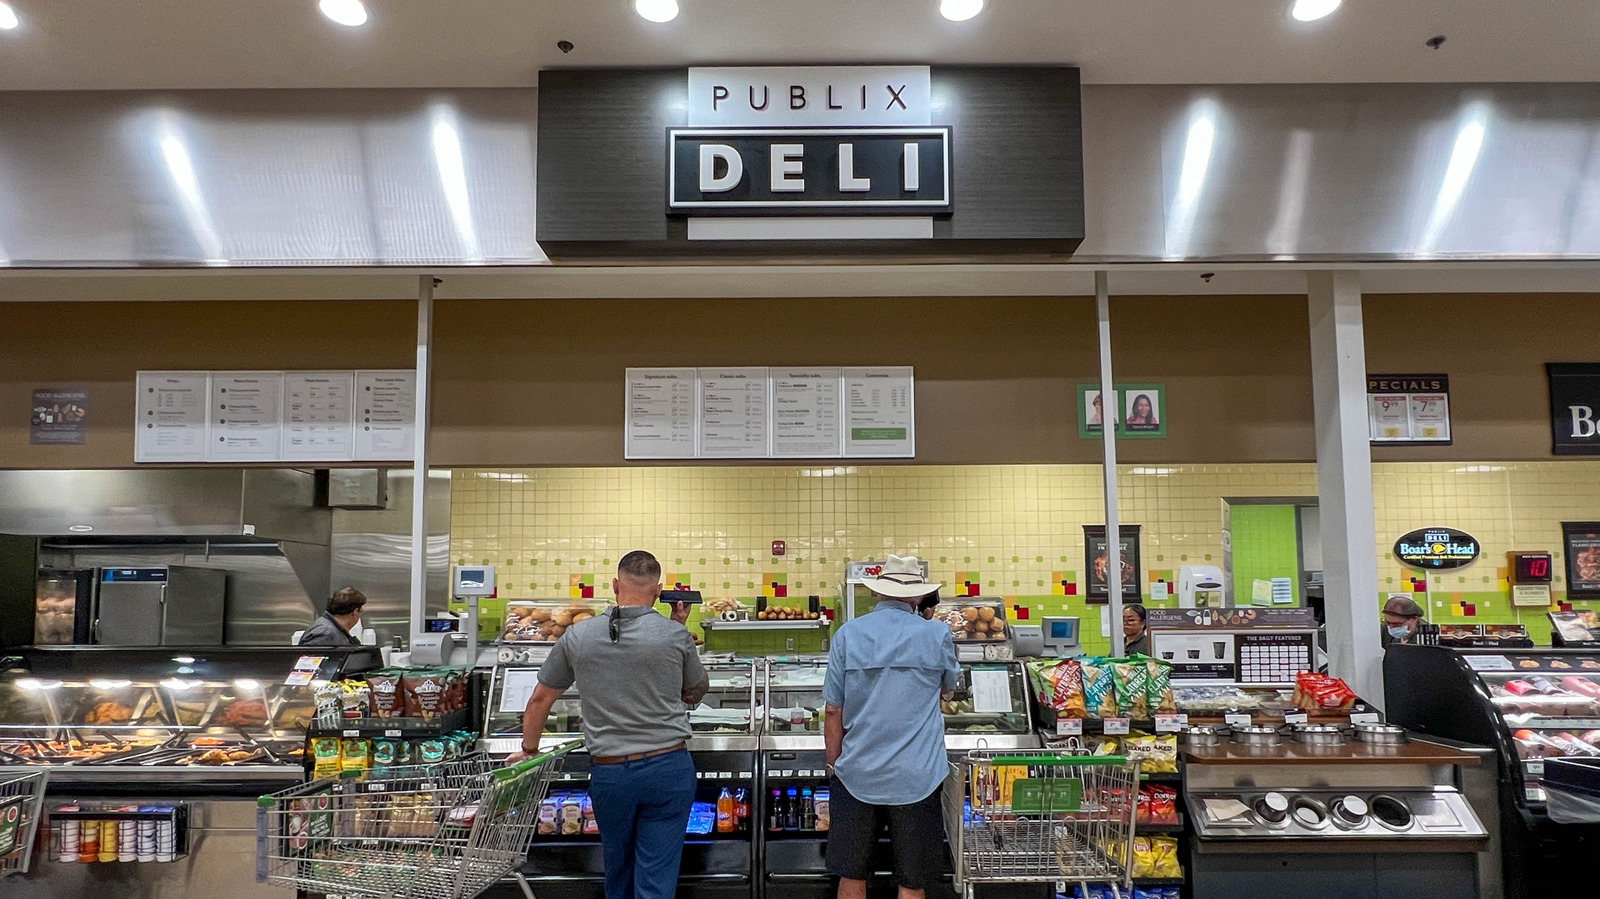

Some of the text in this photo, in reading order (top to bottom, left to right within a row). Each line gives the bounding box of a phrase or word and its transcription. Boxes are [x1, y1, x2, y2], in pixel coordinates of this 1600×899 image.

[712, 84, 908, 111] PUBLIX
[698, 142, 921, 193] DELI
[1369, 381, 1441, 390] PECIALS
[1400, 542, 1475, 555] Boar's Head
